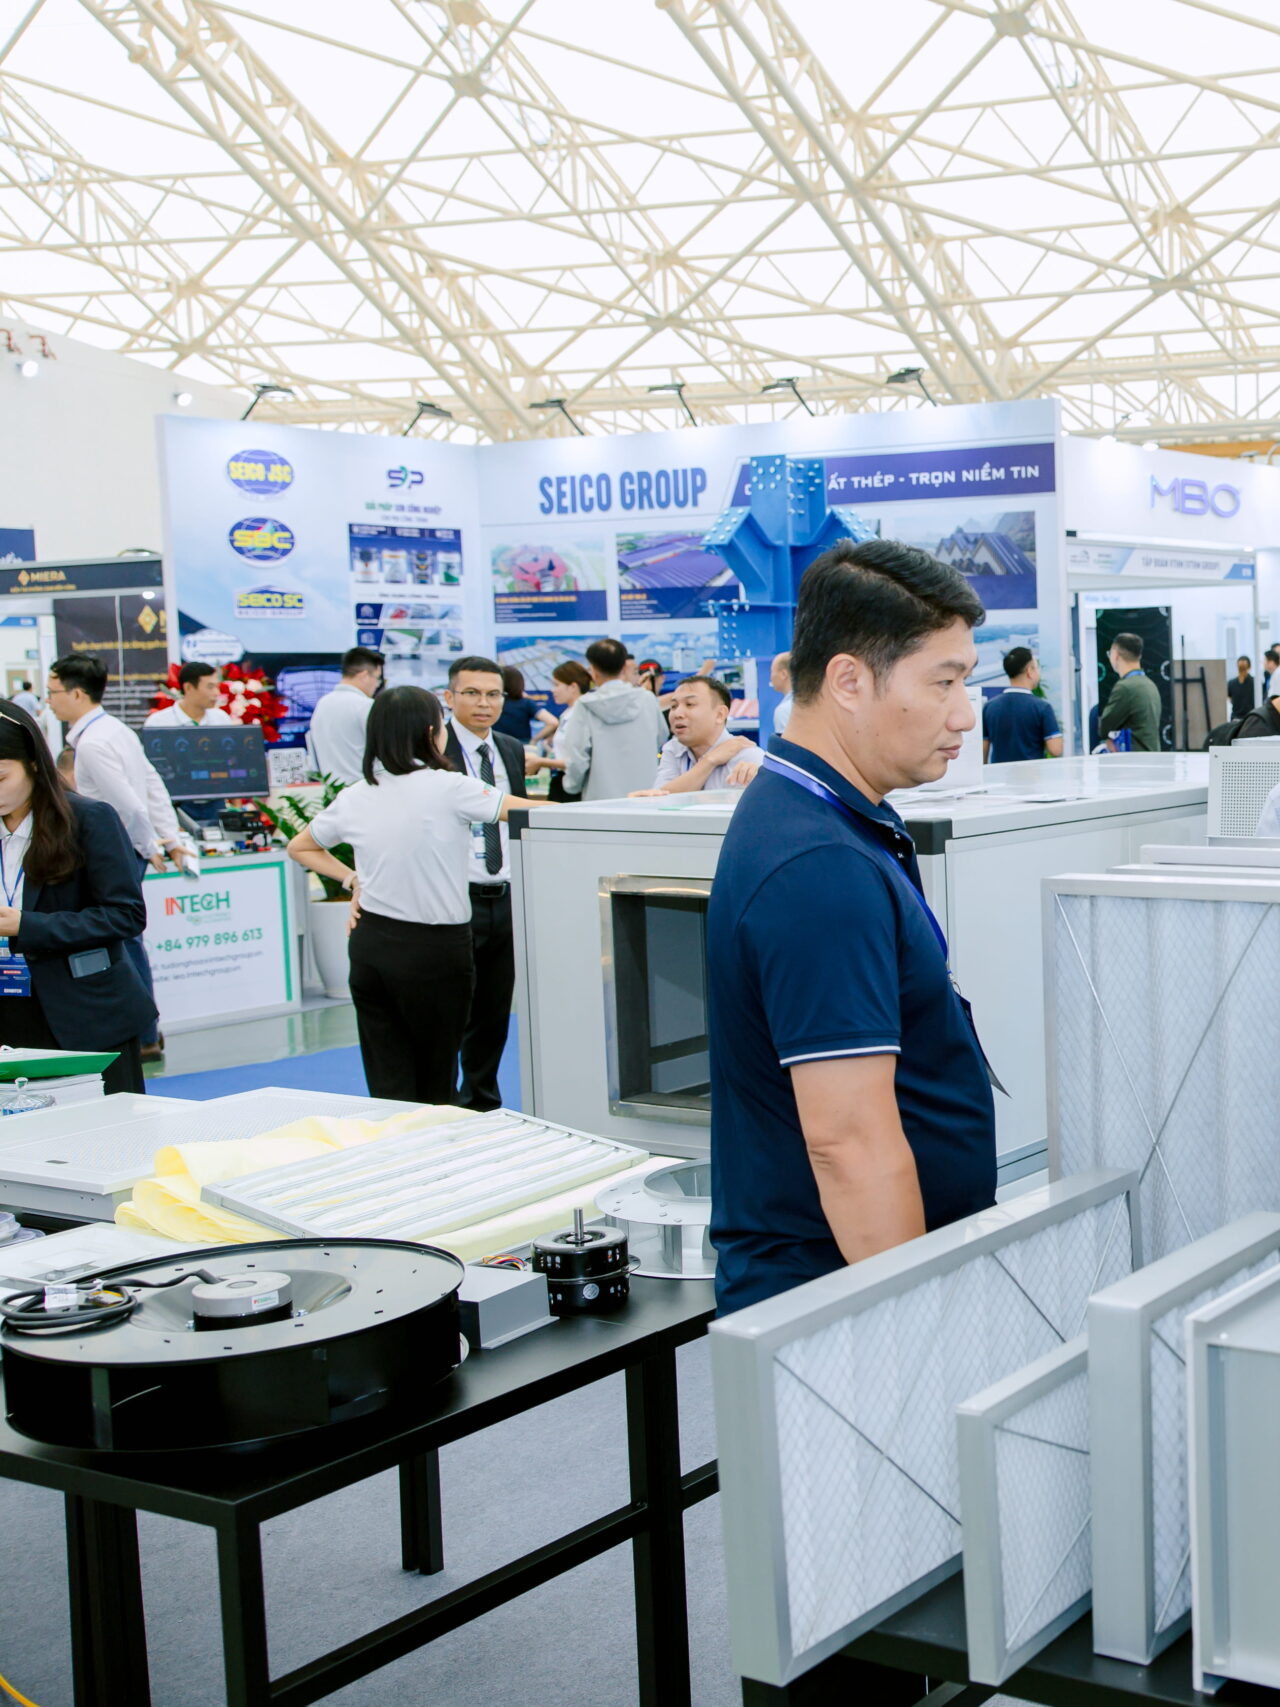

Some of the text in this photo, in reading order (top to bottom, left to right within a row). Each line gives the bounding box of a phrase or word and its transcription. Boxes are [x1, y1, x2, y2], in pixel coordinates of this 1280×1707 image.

[229, 461, 292, 483] SEICO JSC
[828, 475, 846, 490] ẤT
[851, 471, 895, 488] THÉP
[908, 470, 956, 487] TRỌN
[962, 462, 1006, 482] NIỀM
[1009, 465, 1039, 479] TIN
[539, 467, 707, 515] SEICO GROUP
[1150, 474, 1241, 519] MBO
[232, 530, 292, 549] SBC
[238, 593, 304, 607] SEICO SC
[165, 890, 231, 916] INTECH
[156, 927, 263, 952] +84 979 896 613
